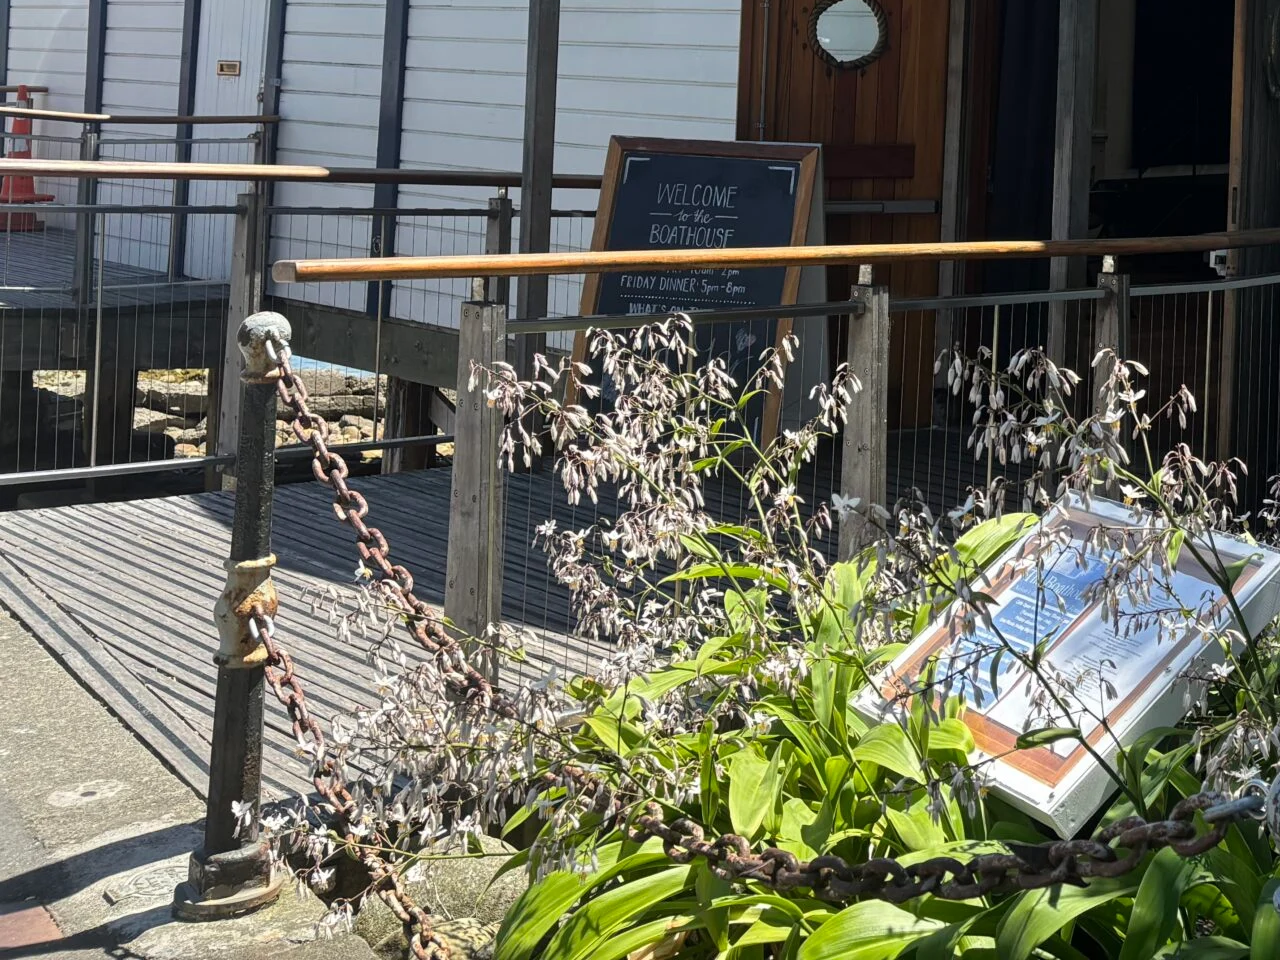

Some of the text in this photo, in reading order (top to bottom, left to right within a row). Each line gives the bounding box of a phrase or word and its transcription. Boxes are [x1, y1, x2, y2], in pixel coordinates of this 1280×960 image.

[657, 183, 738, 209] WELCOME
[673, 208, 714, 224] to the
[620, 274, 657, 290] FRIDAY
